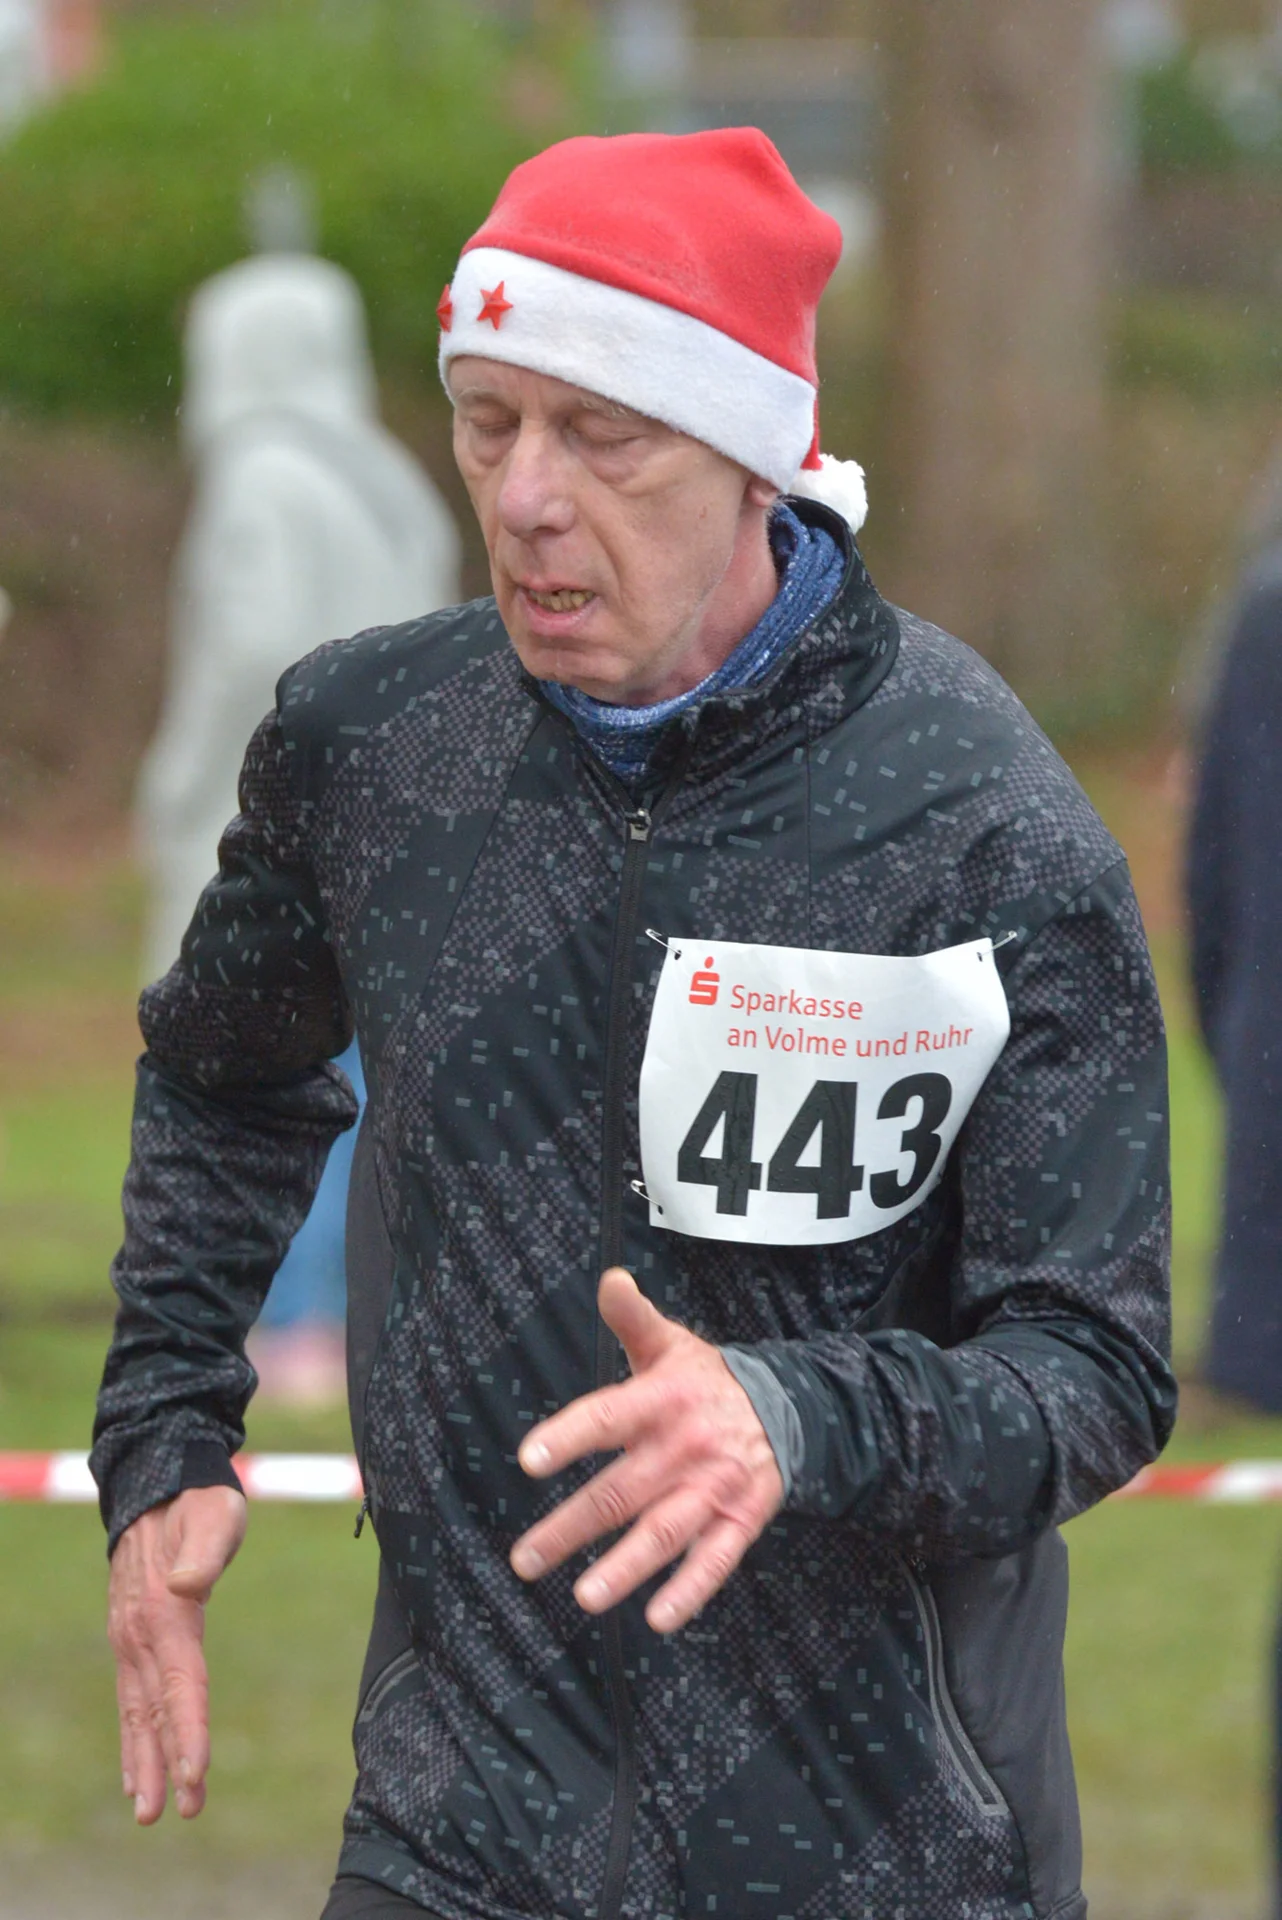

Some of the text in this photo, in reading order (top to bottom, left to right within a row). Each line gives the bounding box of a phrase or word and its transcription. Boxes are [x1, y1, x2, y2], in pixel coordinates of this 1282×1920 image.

[730, 984, 863, 1020] Sparkasse
[727, 1025, 973, 1058] an Volme und Ruhr
[677, 1070, 952, 1220] 443
